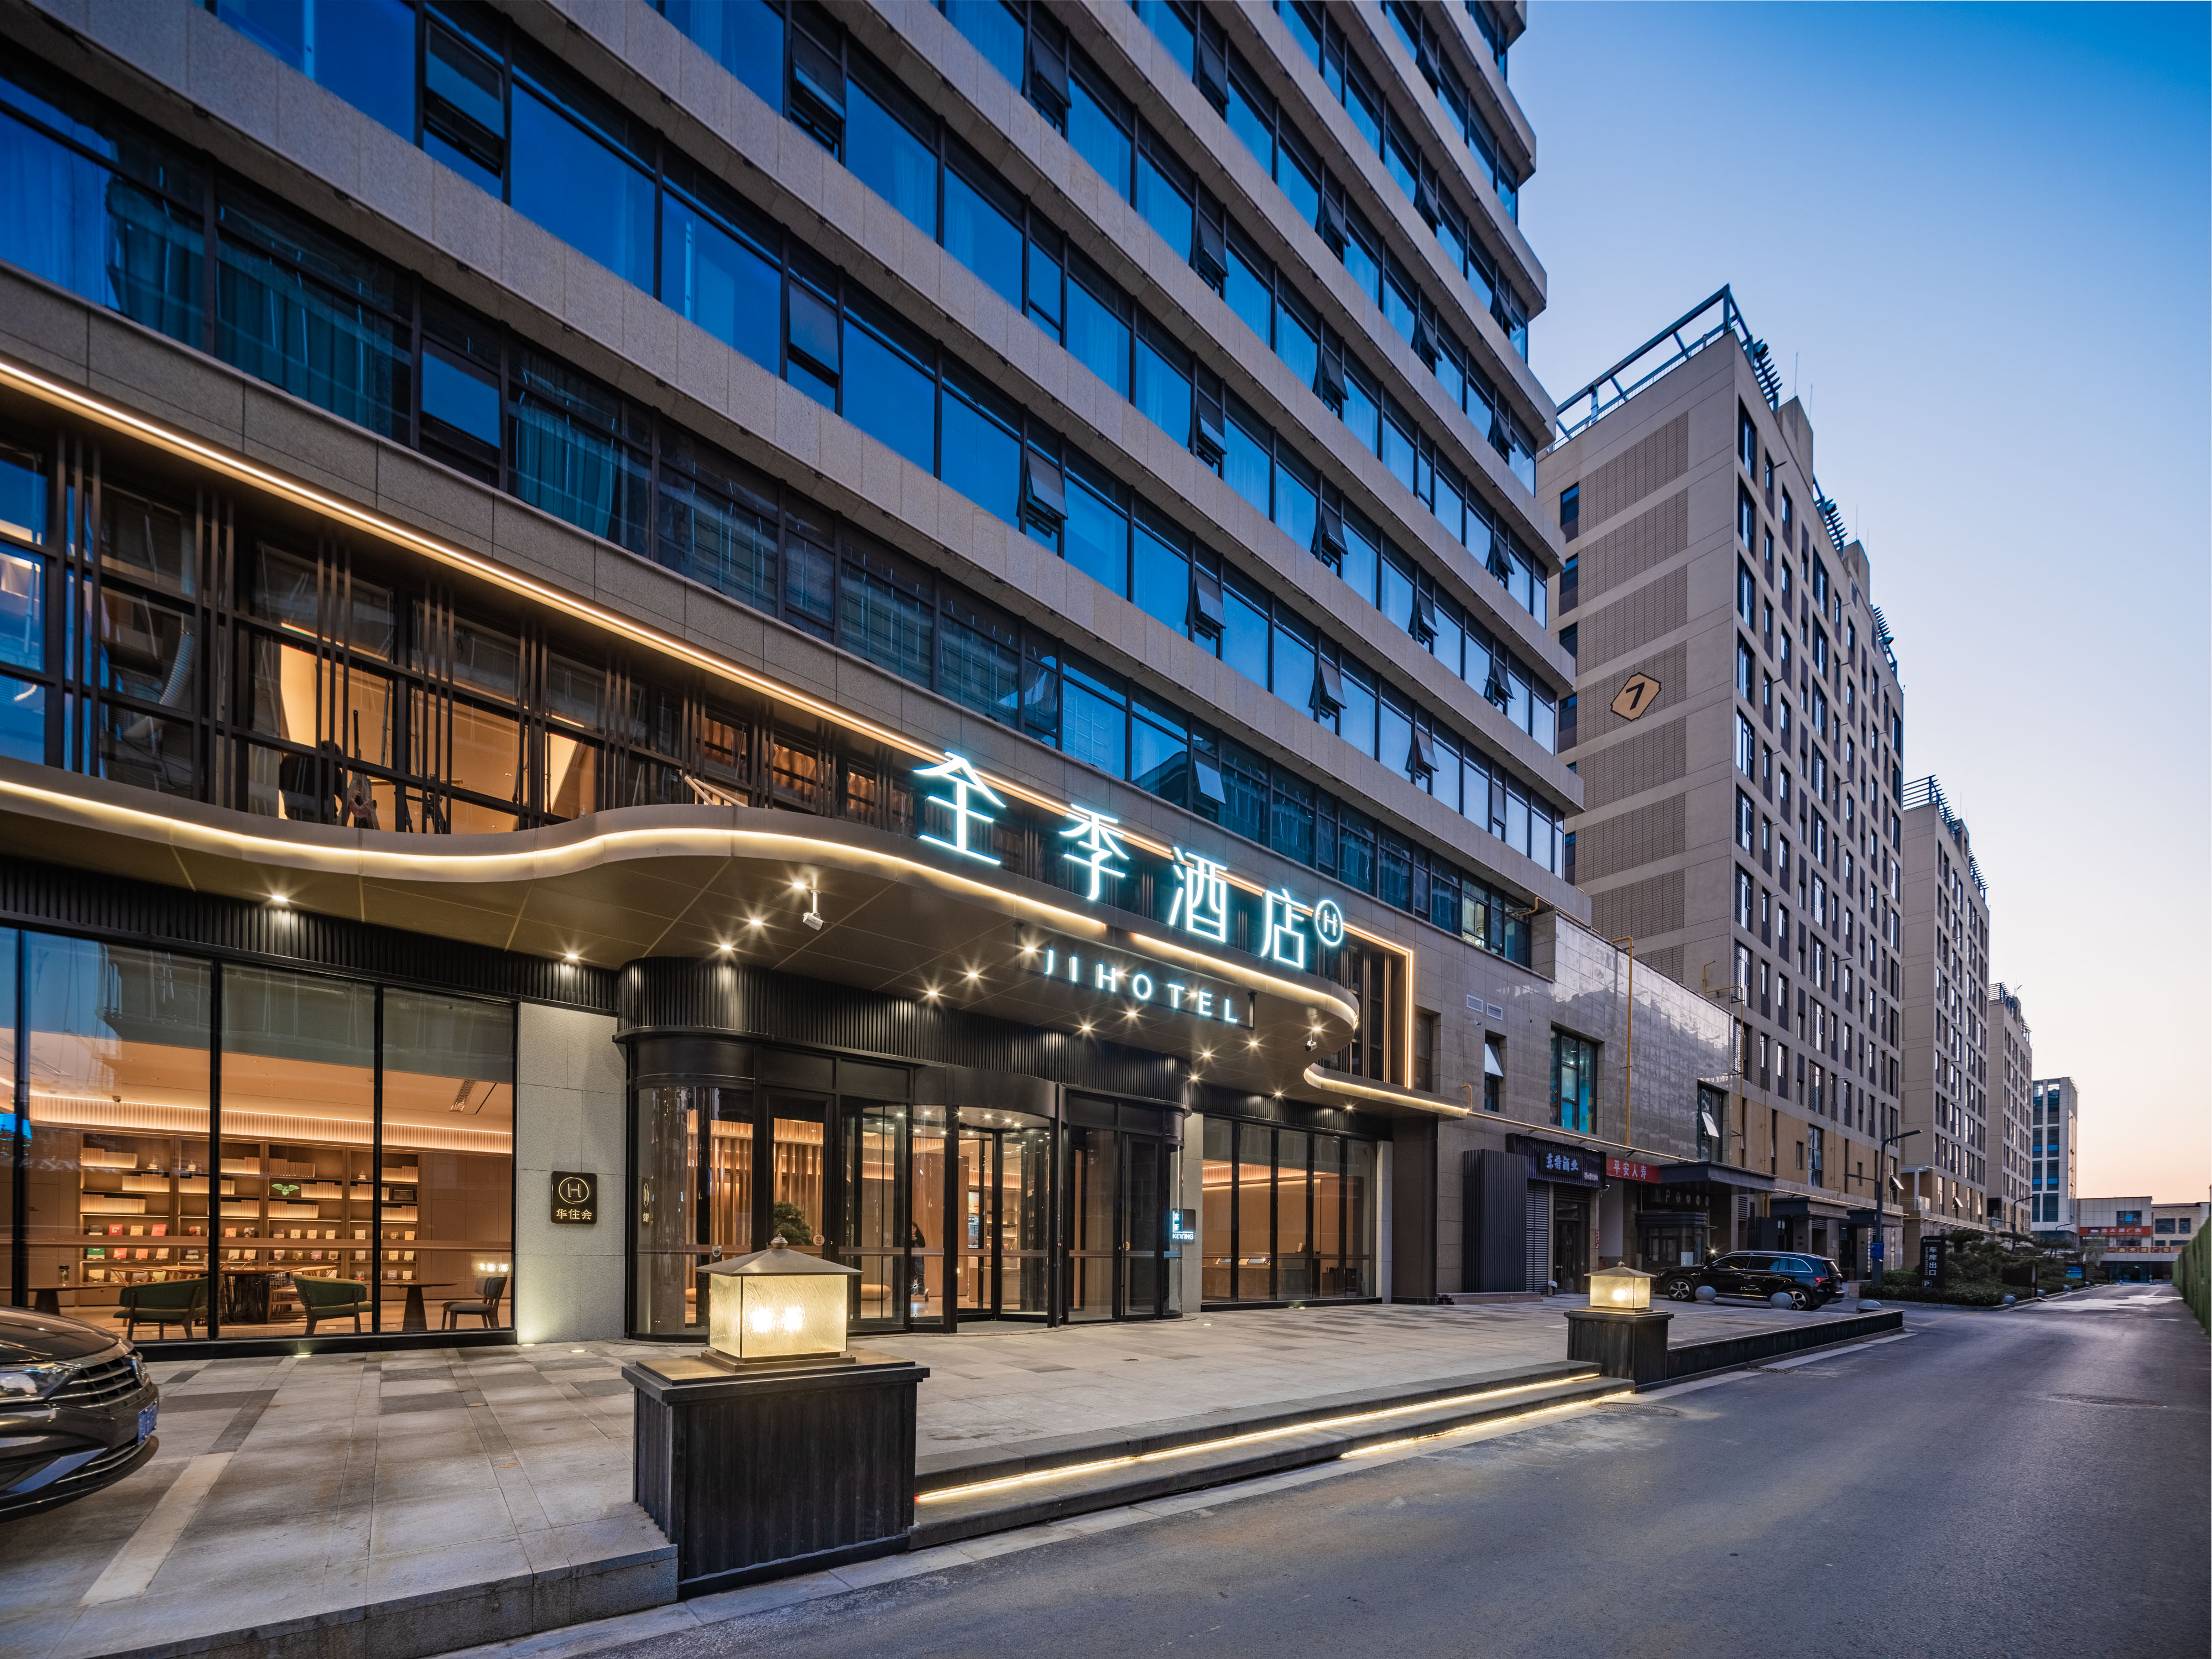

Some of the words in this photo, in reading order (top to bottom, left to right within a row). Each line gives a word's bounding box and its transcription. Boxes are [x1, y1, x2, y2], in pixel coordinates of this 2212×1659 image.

[1625, 681, 1645, 711] 7
[913, 750, 1308, 969] 全季酒店
[1614, 1160, 1647, 1180] 平安人寿
[556, 1208, 593, 1220] 华住会
[1928, 1246, 1938, 1276] 车库出口
